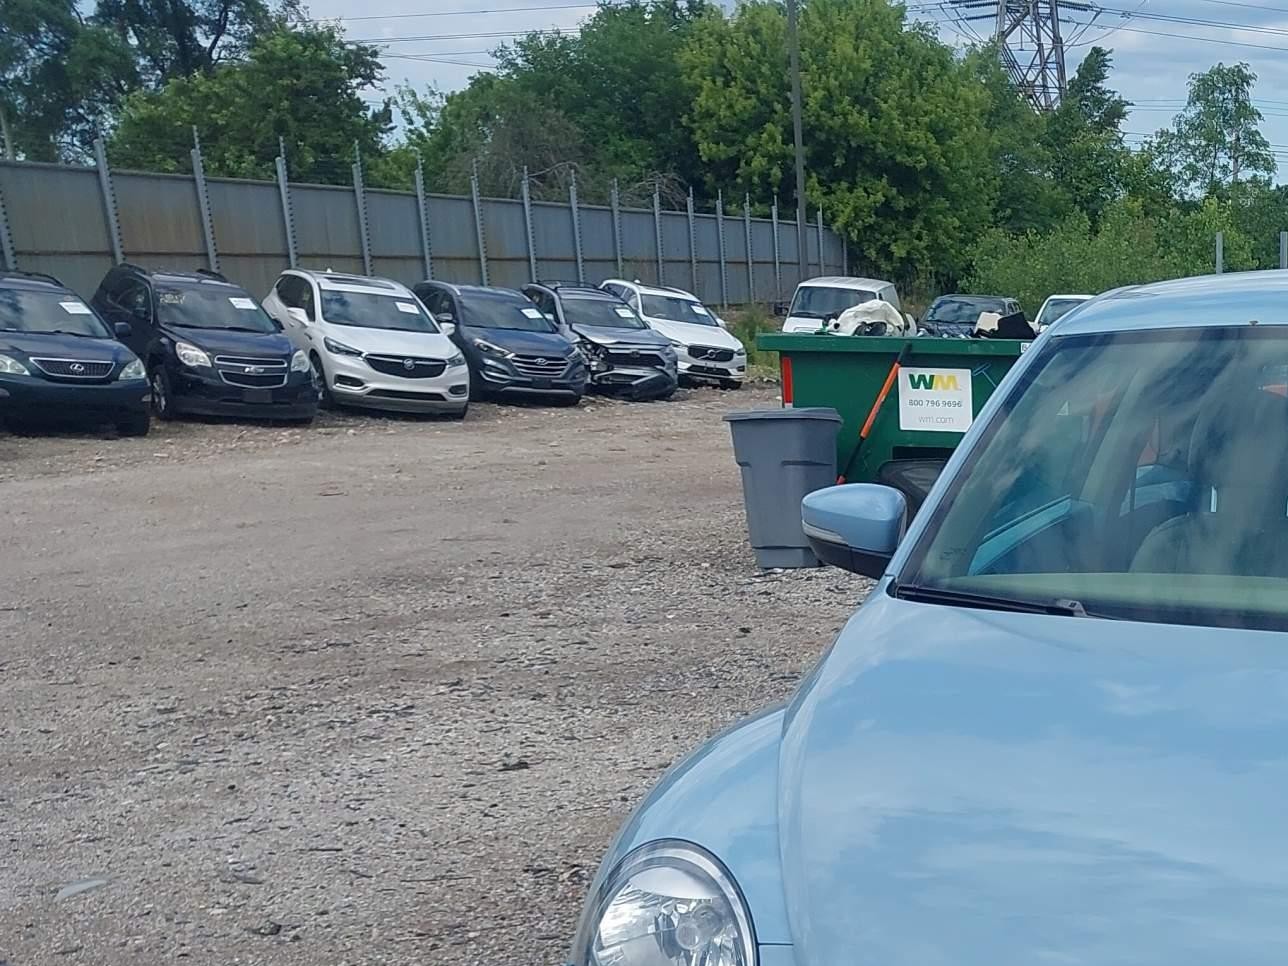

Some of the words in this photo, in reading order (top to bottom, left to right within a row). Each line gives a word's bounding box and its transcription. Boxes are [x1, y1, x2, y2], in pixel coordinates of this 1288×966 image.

[908, 373, 960, 391] WM
[908, 399, 923, 407] 800
[925, 400, 940, 408] 796
[918, 416, 954, 424] wm.com
